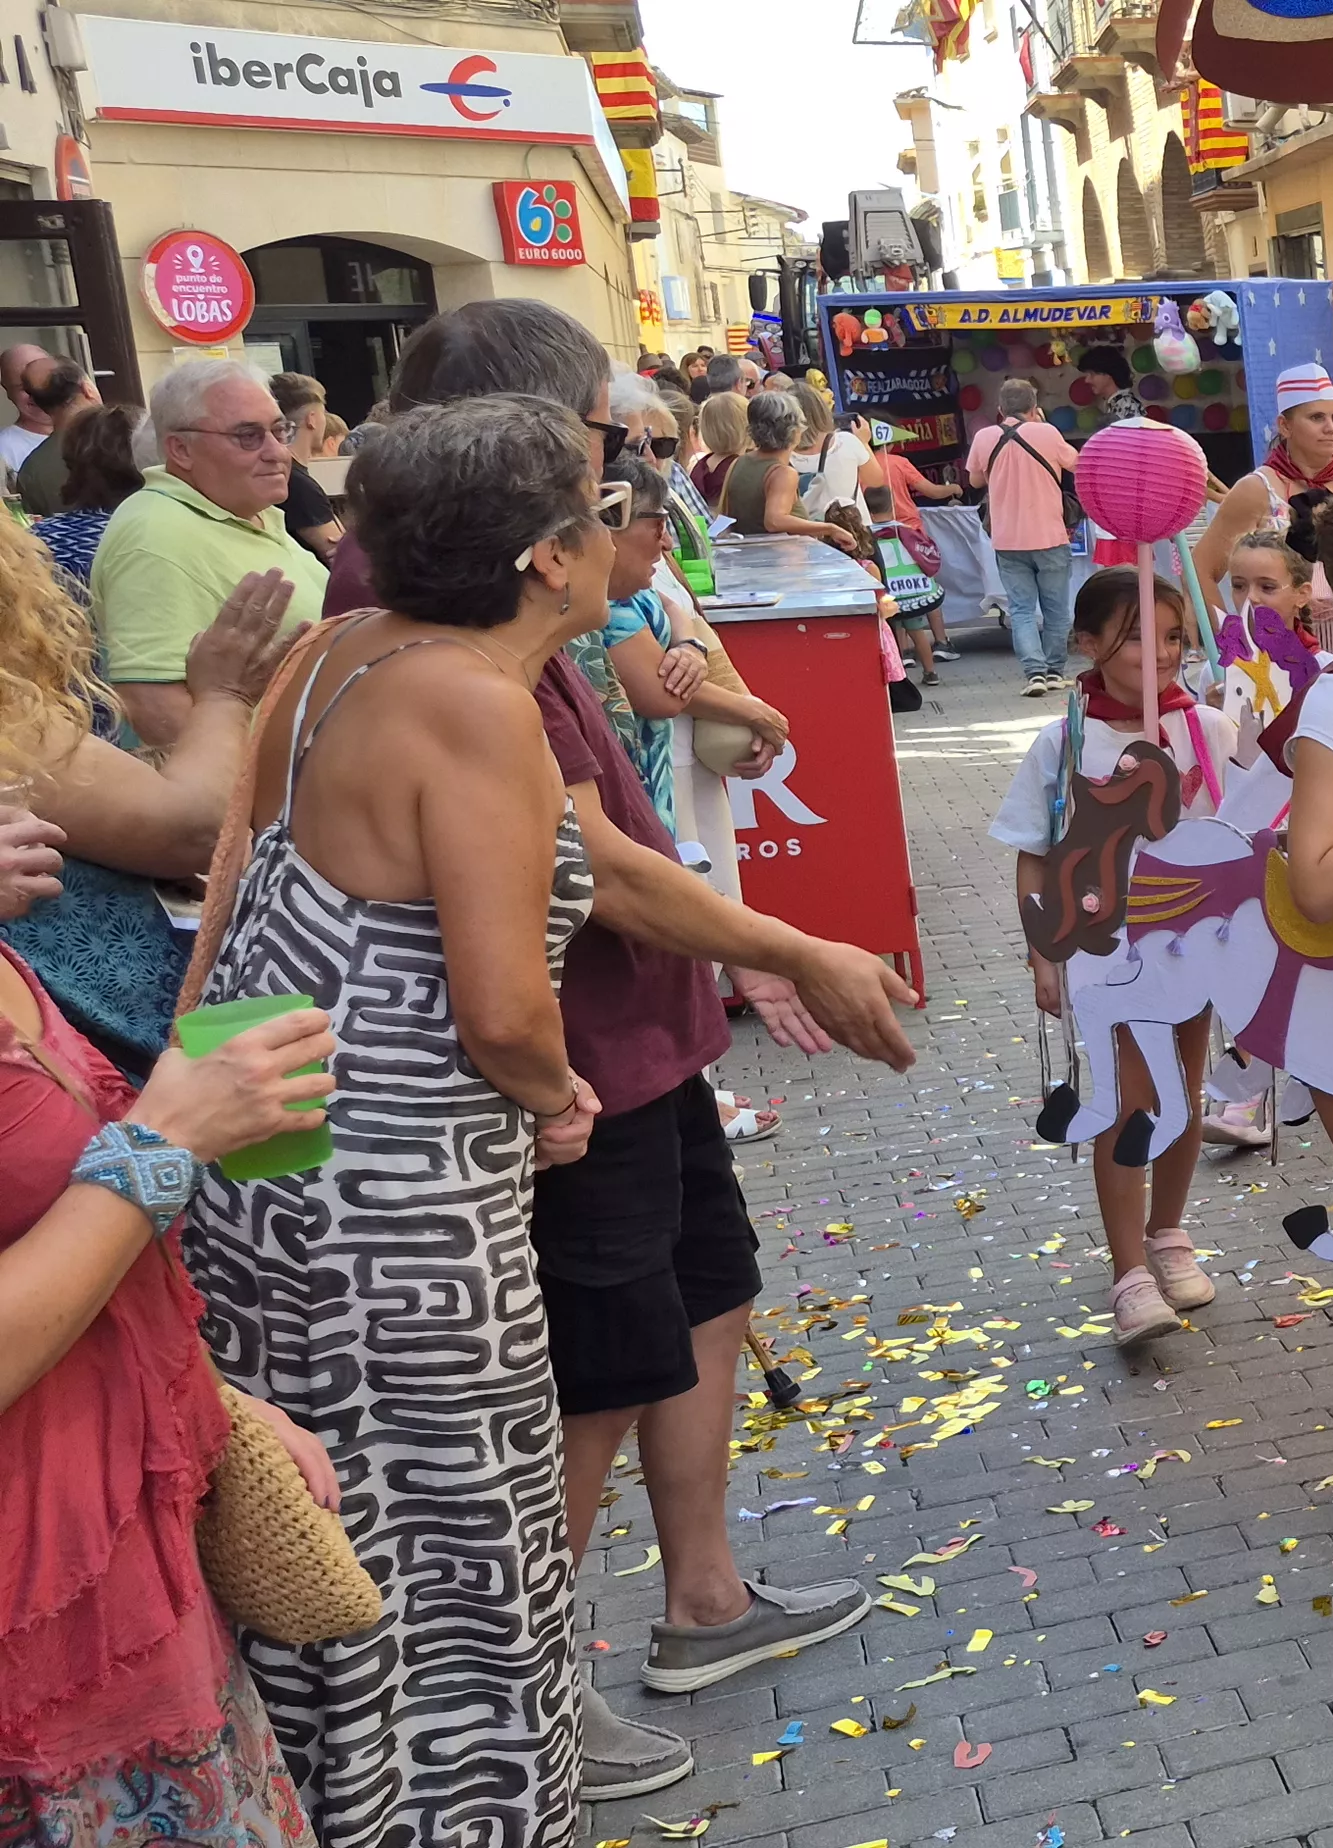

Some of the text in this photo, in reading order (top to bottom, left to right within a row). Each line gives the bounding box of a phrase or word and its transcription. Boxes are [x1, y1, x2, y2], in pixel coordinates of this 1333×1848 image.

[190, 41, 402, 108] iberCaja
[518, 247, 582, 260] EURO 6000
[176, 274, 223, 284] punto de
[172, 284, 228, 294] encuentro
[172, 298, 233, 324] LOBAS
[959, 305, 1112, 323] A.D. ALMUDEVAR
[875, 426, 889, 440] 67
[890, 577, 930, 592] CHOKE
